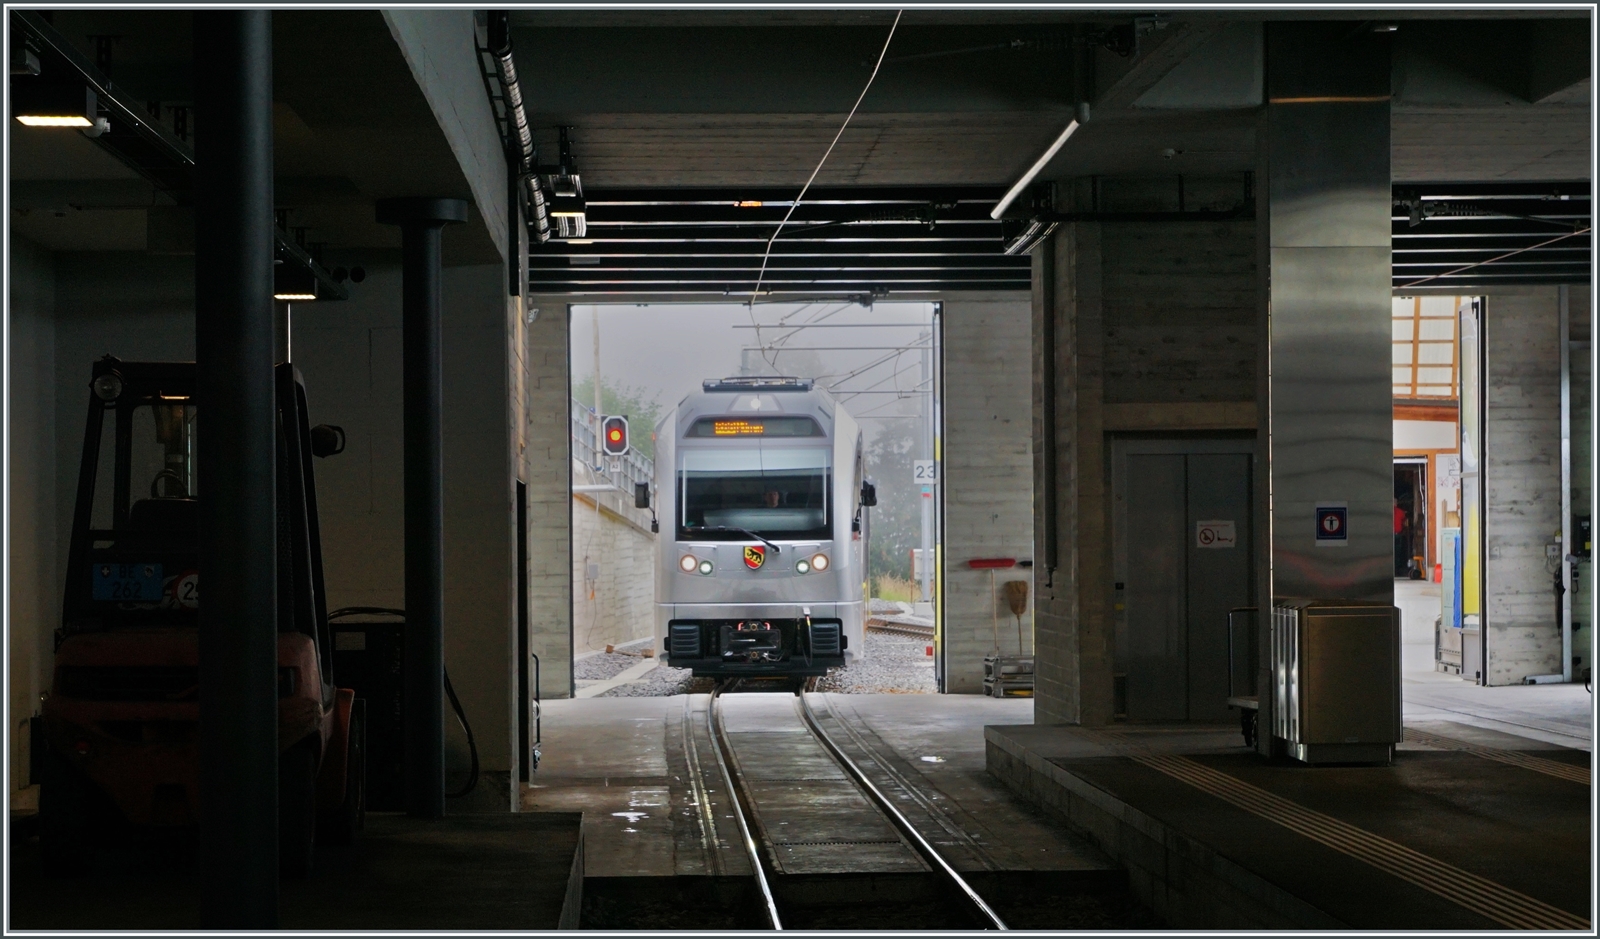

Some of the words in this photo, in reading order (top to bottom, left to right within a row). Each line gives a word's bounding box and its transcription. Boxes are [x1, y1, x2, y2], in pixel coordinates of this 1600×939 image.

[916, 465, 934, 478] 23
[119, 565, 135, 579] BE
[112, 581, 142, 598] 262
[183, 581, 199, 600] 2
